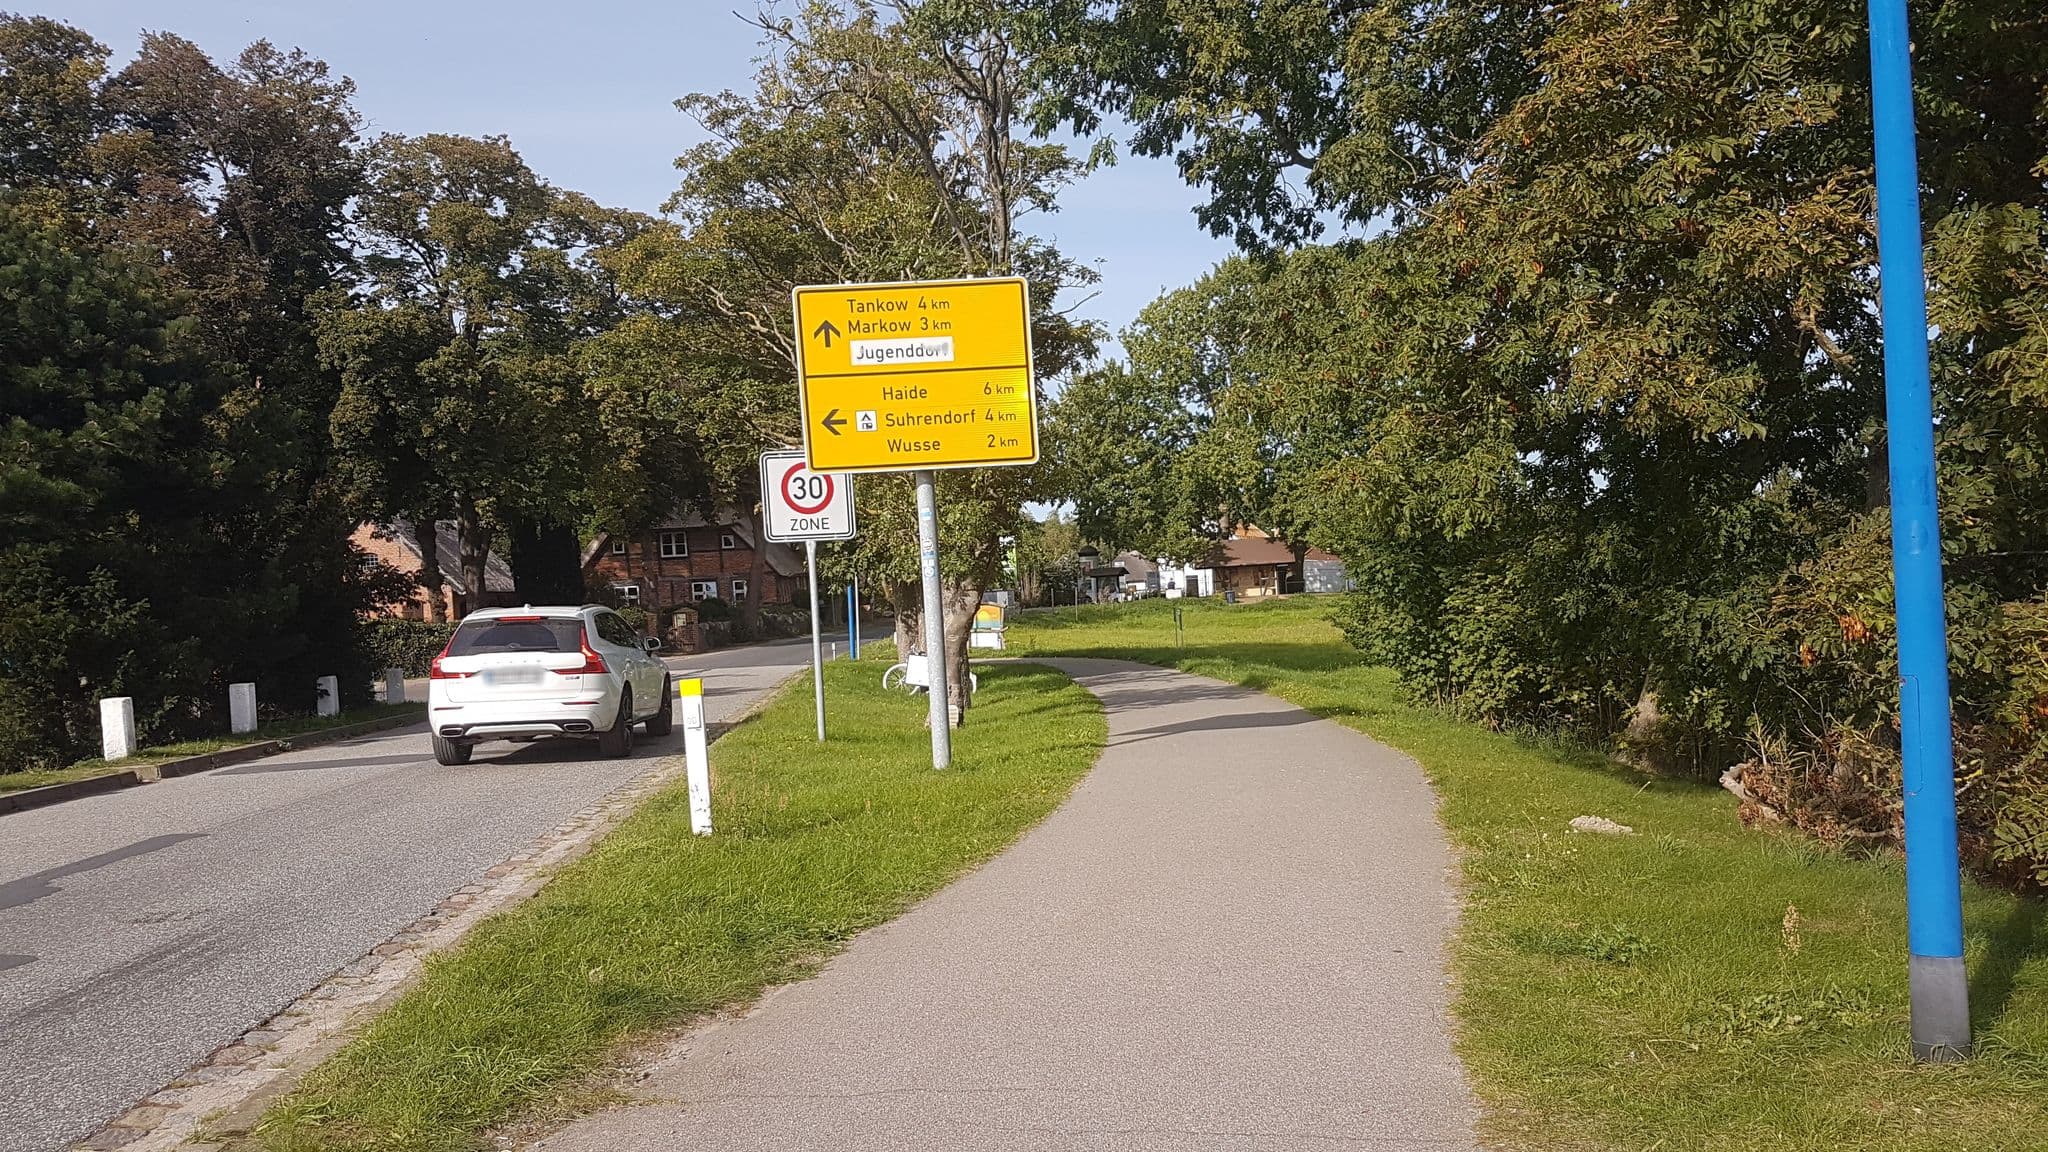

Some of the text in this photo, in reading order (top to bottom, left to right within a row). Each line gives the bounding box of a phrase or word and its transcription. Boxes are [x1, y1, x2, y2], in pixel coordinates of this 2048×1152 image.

[847, 297, 950, 314] Tankow 4 km
[848, 317, 952, 334] Markow 3 km
[857, 342, 948, 362] Jugenddor
[882, 382, 1015, 401] Haide 6 km
[885, 408, 1017, 427] Suhrendorf 4 km
[887, 435, 1019, 453] Wusse 2 km
[792, 476, 823, 500] 30
[790, 517, 830, 531] ZONE
